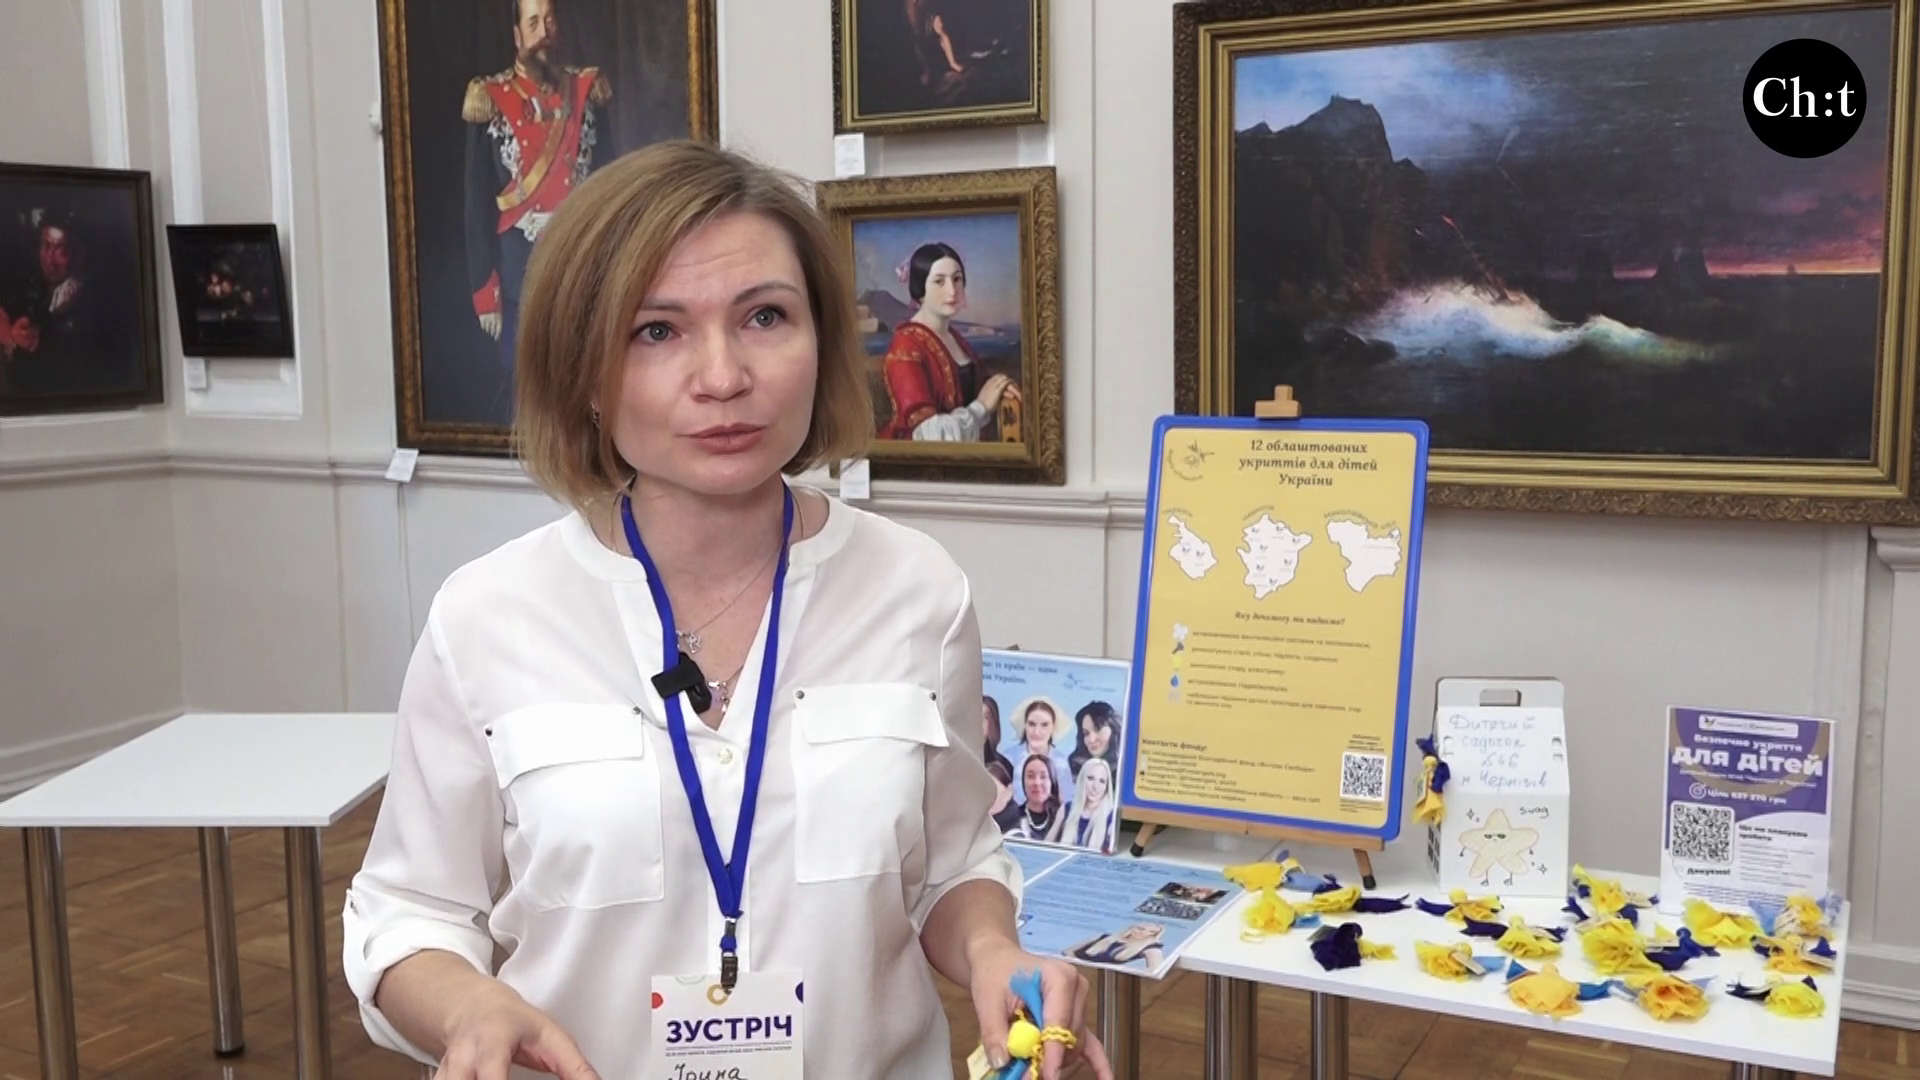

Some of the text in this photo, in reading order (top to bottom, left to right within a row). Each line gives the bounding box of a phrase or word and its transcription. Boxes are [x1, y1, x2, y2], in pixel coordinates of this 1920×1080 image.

[1250, 439, 1368, 454] 12 облаштованих
[1238, 456, 1378, 472] укриттів для дітей
[1278, 473, 1333, 489] України
[1694, 734, 1803, 752] Безпечне укриття
[1672, 746, 1824, 777] для дітей
[665, 1014, 793, 1043] ЗУСТРІЧ
